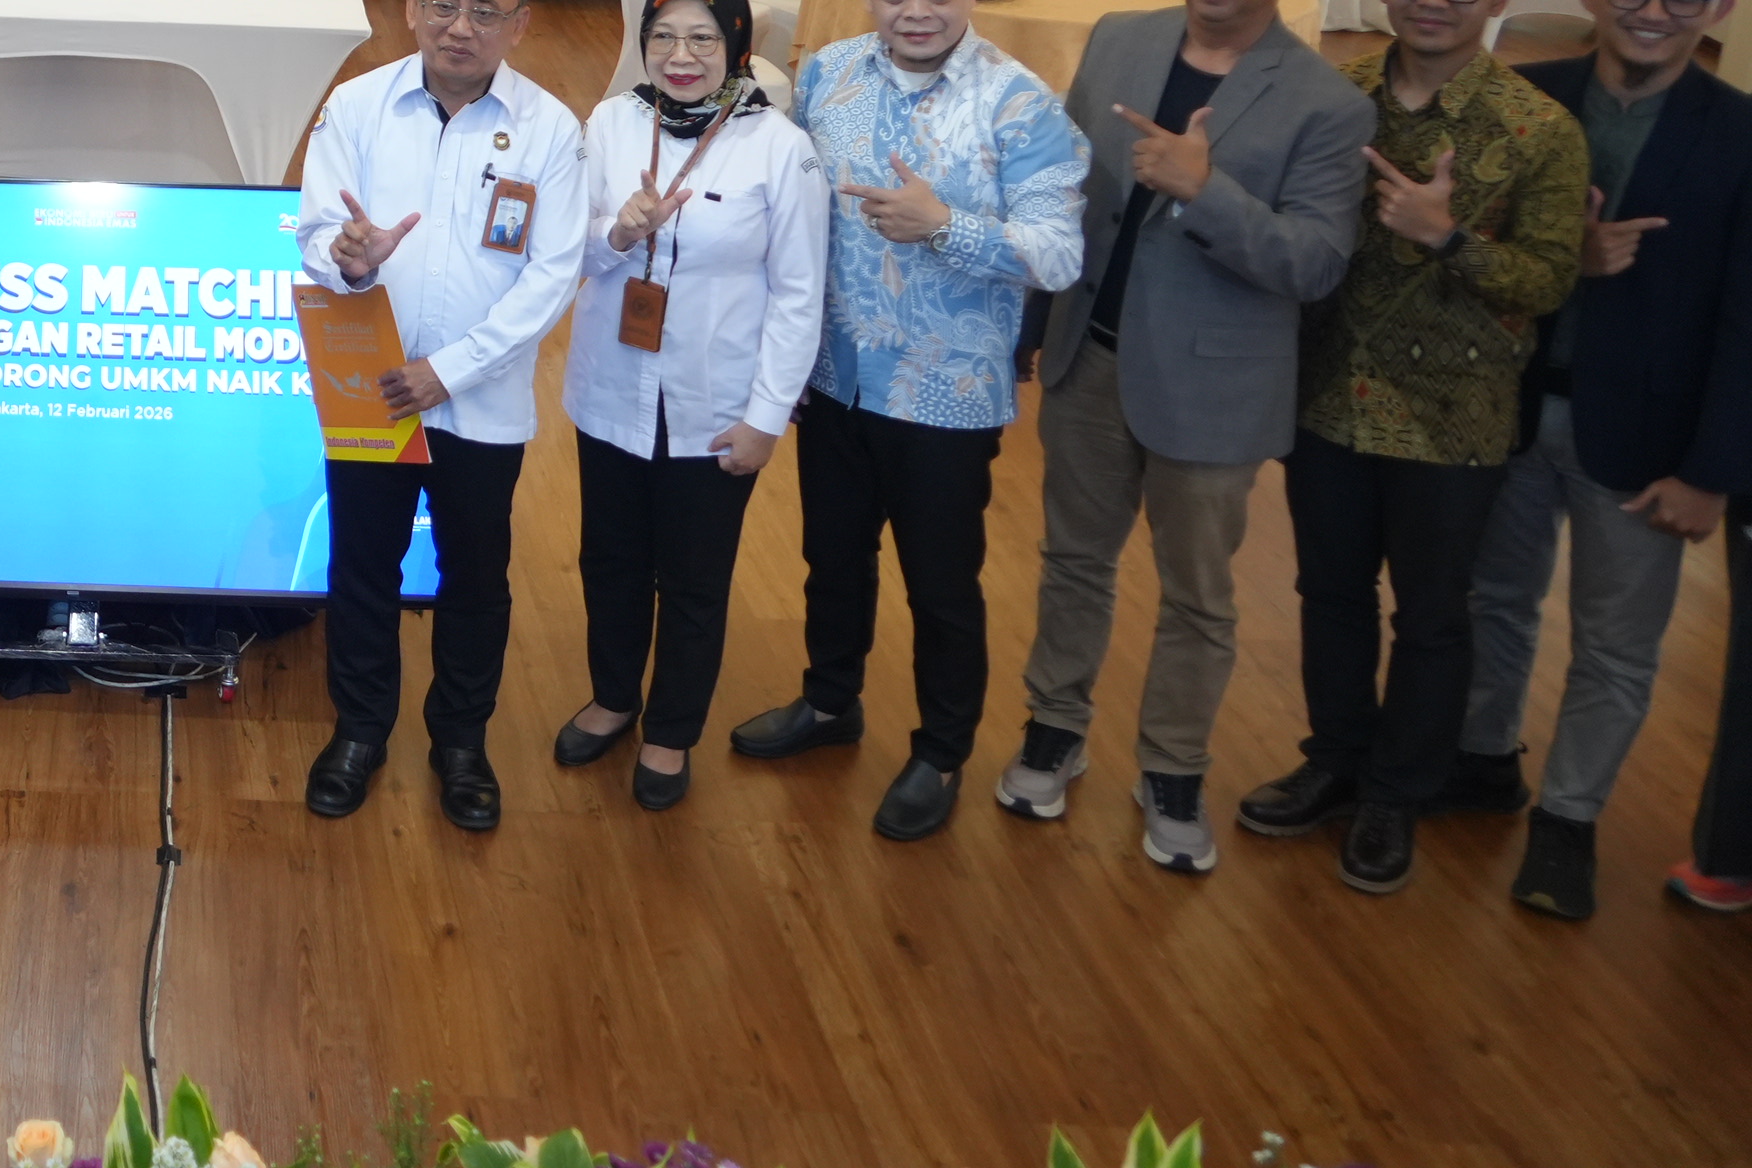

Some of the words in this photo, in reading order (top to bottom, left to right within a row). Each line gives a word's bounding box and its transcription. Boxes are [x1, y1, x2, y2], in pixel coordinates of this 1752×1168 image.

[106, 218, 137, 228] EMAS
[76, 322, 206, 361] RETAIL
[214, 326, 307, 365] MOD
[100, 365, 196, 393] UMKM
[207, 369, 283, 396] NAIK
[291, 370, 313, 396] K
[48, 402, 63, 417] 12
[67, 402, 130, 419] Februari
[134, 405, 173, 421] 2026
[325, 436, 360, 448] Indonesia
[360, 437, 396, 450] Kompeten
